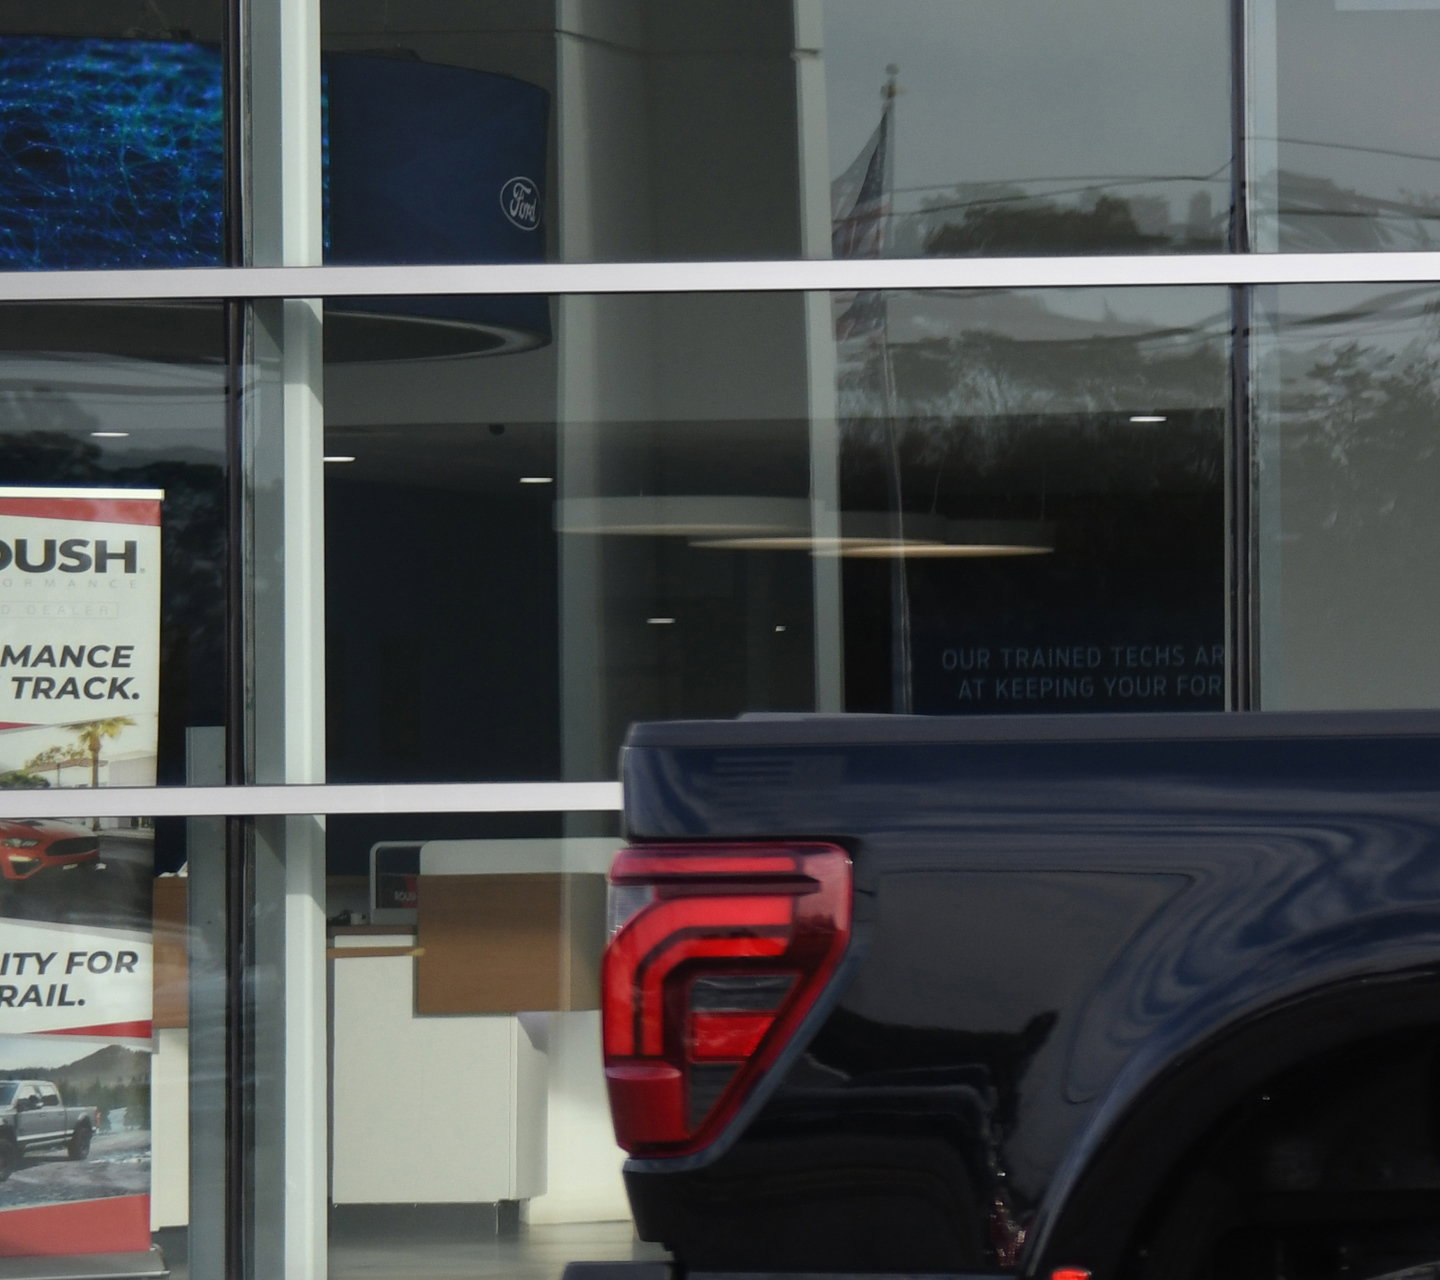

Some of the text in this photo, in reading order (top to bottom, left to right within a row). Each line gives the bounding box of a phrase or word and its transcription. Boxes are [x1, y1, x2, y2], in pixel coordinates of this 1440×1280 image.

[509, 181, 538, 223] Ford
[0, 538, 137, 574] USH
[26, 604, 109, 616] DEALER
[0, 644, 135, 669] MANCE
[942, 649, 991, 670] OUR
[1110, 646, 1185, 668] TECHS
[11, 676, 141, 700] TRACK.
[958, 678, 988, 700] AT
[995, 676, 1095, 700] KEEPING
[1104, 675, 1167, 698] YOUR
[65, 950, 139, 975] FOR
